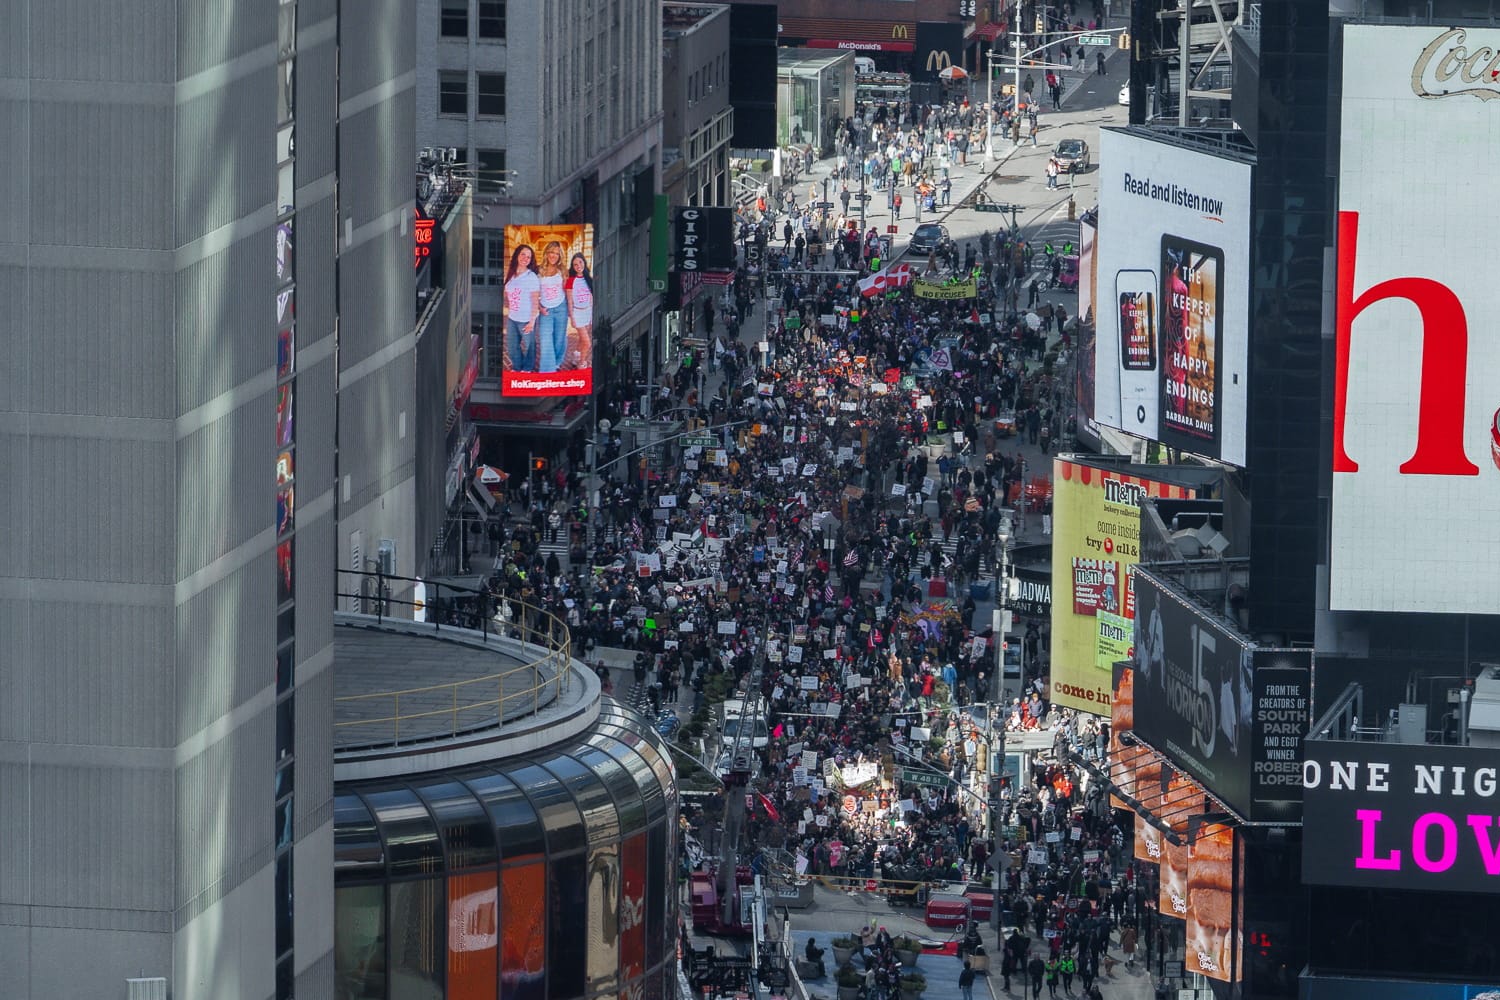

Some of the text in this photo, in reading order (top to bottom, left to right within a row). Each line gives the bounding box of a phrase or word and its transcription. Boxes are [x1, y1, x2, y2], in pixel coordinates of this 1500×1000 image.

[838, 42, 881, 51] McDonald's
[1124, 172, 1223, 216] Read and listen now
[682, 209, 698, 270] GIFTS
[1182, 265, 1202, 285] THE
[1172, 292, 1211, 316] KEEPER
[1184, 325, 1200, 342] OF
[1173, 351, 1209, 375] HAPPY
[511, 378, 585, 391] NoKingsHere.shop
[1166, 378, 1215, 408] ENDINGS
[1165, 411, 1214, 433] BARBARA DAVIS
[1097, 520, 1117, 536] come
[1086, 535, 1138, 556] try all &
[1055, 681, 1111, 705] come in
[1266, 685, 1300, 696] FROM THE
[1259, 697, 1306, 709] CREATORS OF
[1257, 710, 1307, 722] SOUTH
[1263, 722, 1301, 735] PARK
[1264, 736, 1299, 749] AND EGOT
[1266, 749, 1295, 761] WINNER
[919, 774, 930, 783] 48
[1259, 773, 1304, 785] LOPEZ
[1303, 758, 1390, 792] ONE
